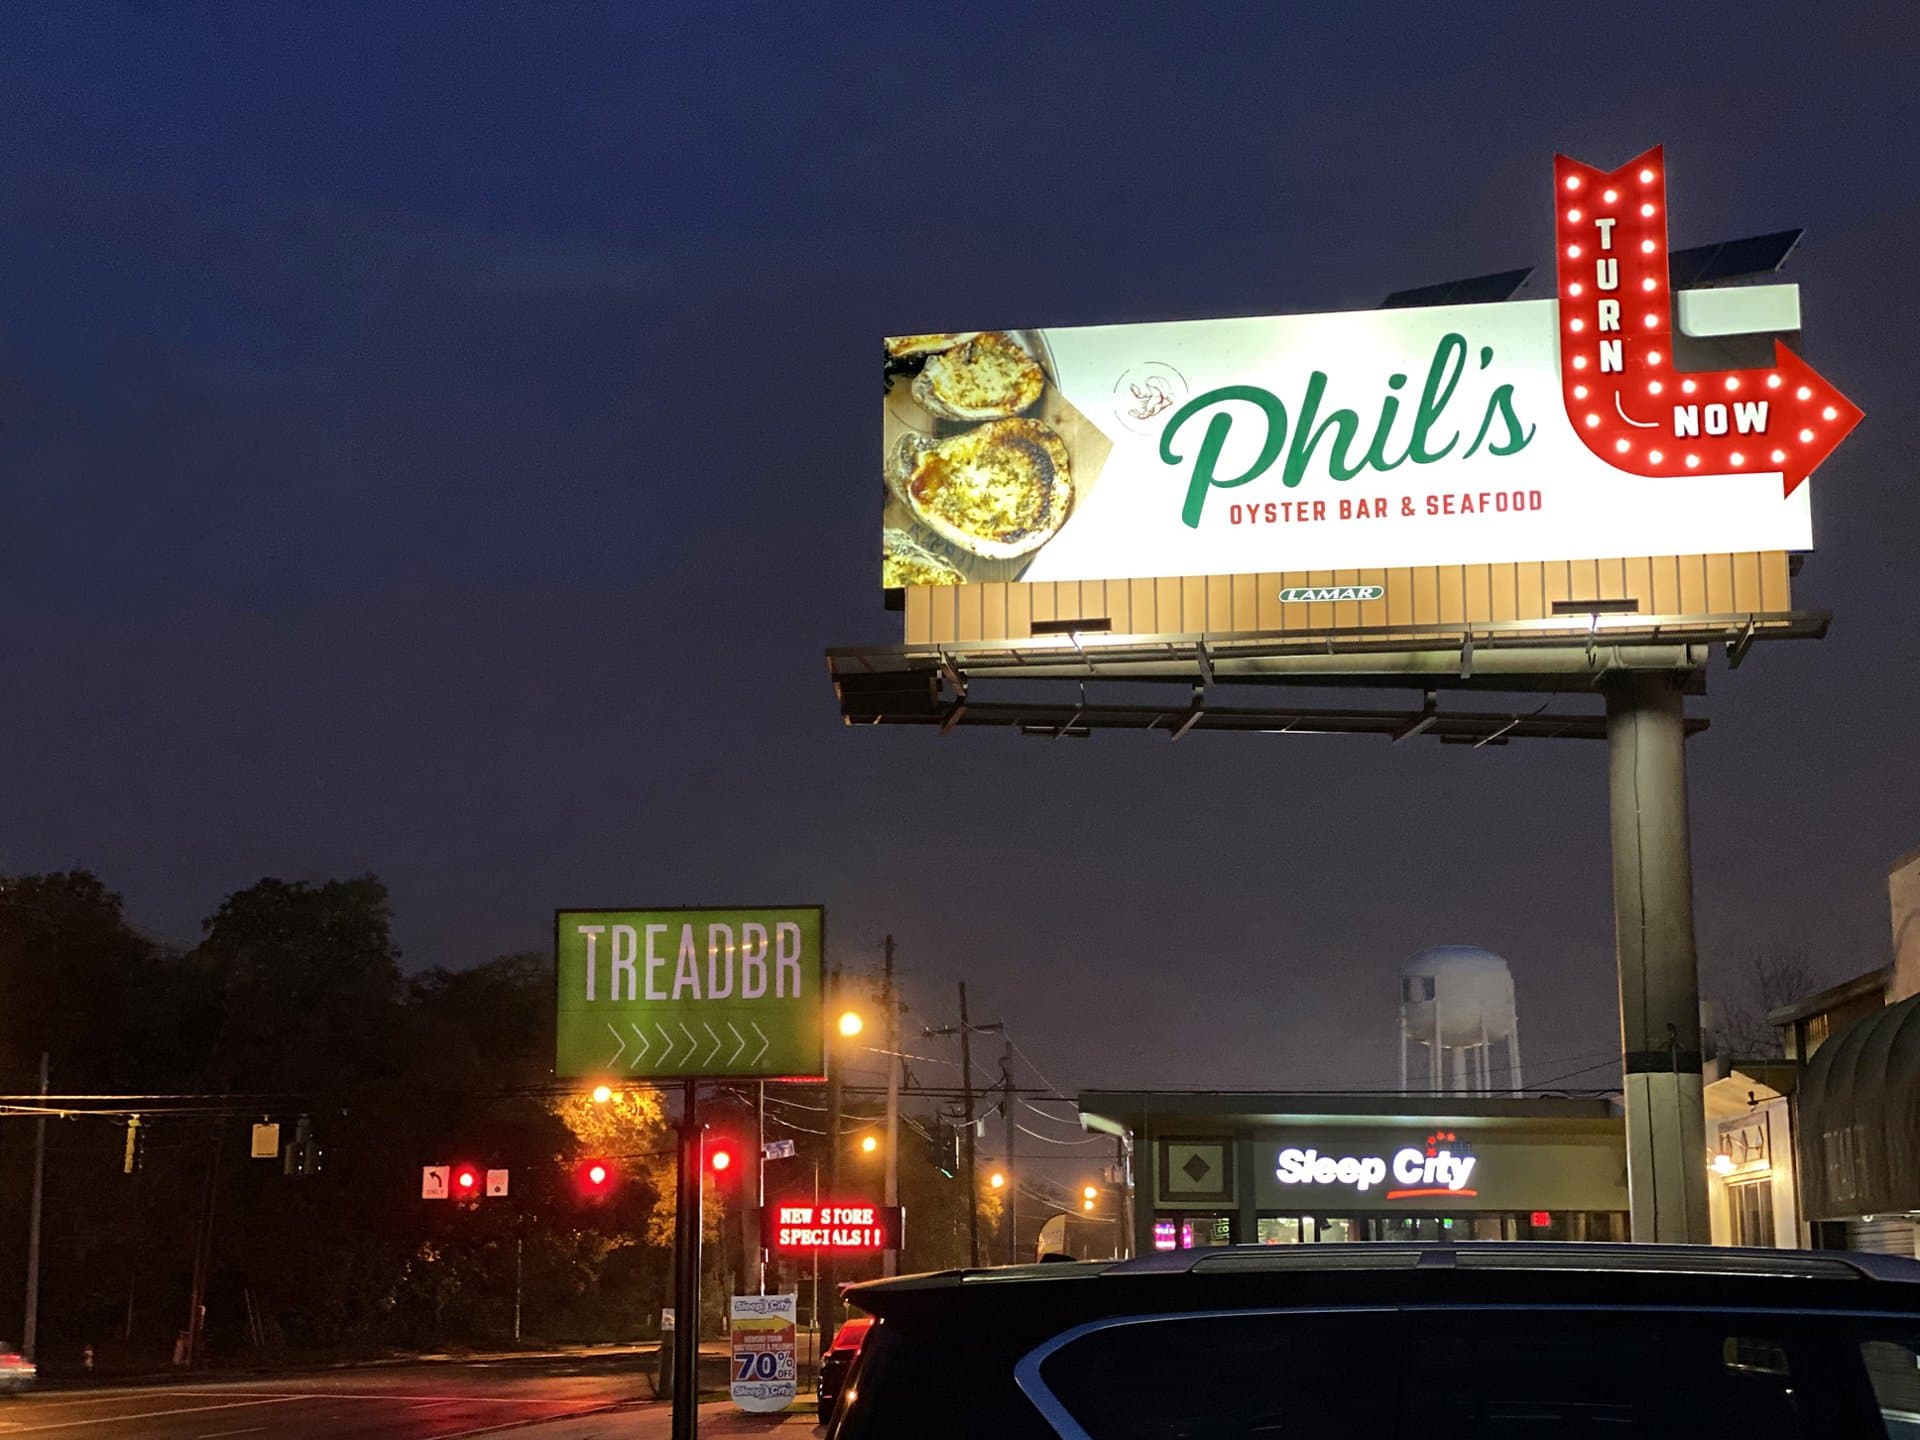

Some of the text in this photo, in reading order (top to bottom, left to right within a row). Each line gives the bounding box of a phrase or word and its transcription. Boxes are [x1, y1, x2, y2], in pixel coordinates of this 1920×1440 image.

[1595, 217, 1623, 373] TURN
[1158, 332, 1537, 529] Phil's
[1673, 401, 1769, 437] NOW
[1229, 490, 1542, 525] OYSTER BAR & SEAFOOD
[1287, 587, 1374, 601] LAMAR
[577, 921, 801, 1001] TREADBR
[1275, 1147, 1477, 1191] Sleep City
[780, 1208, 874, 1225] NEW STORE
[779, 1229, 881, 1246] SPECIALS!!
[778, 1369, 793, 1379] OFF
